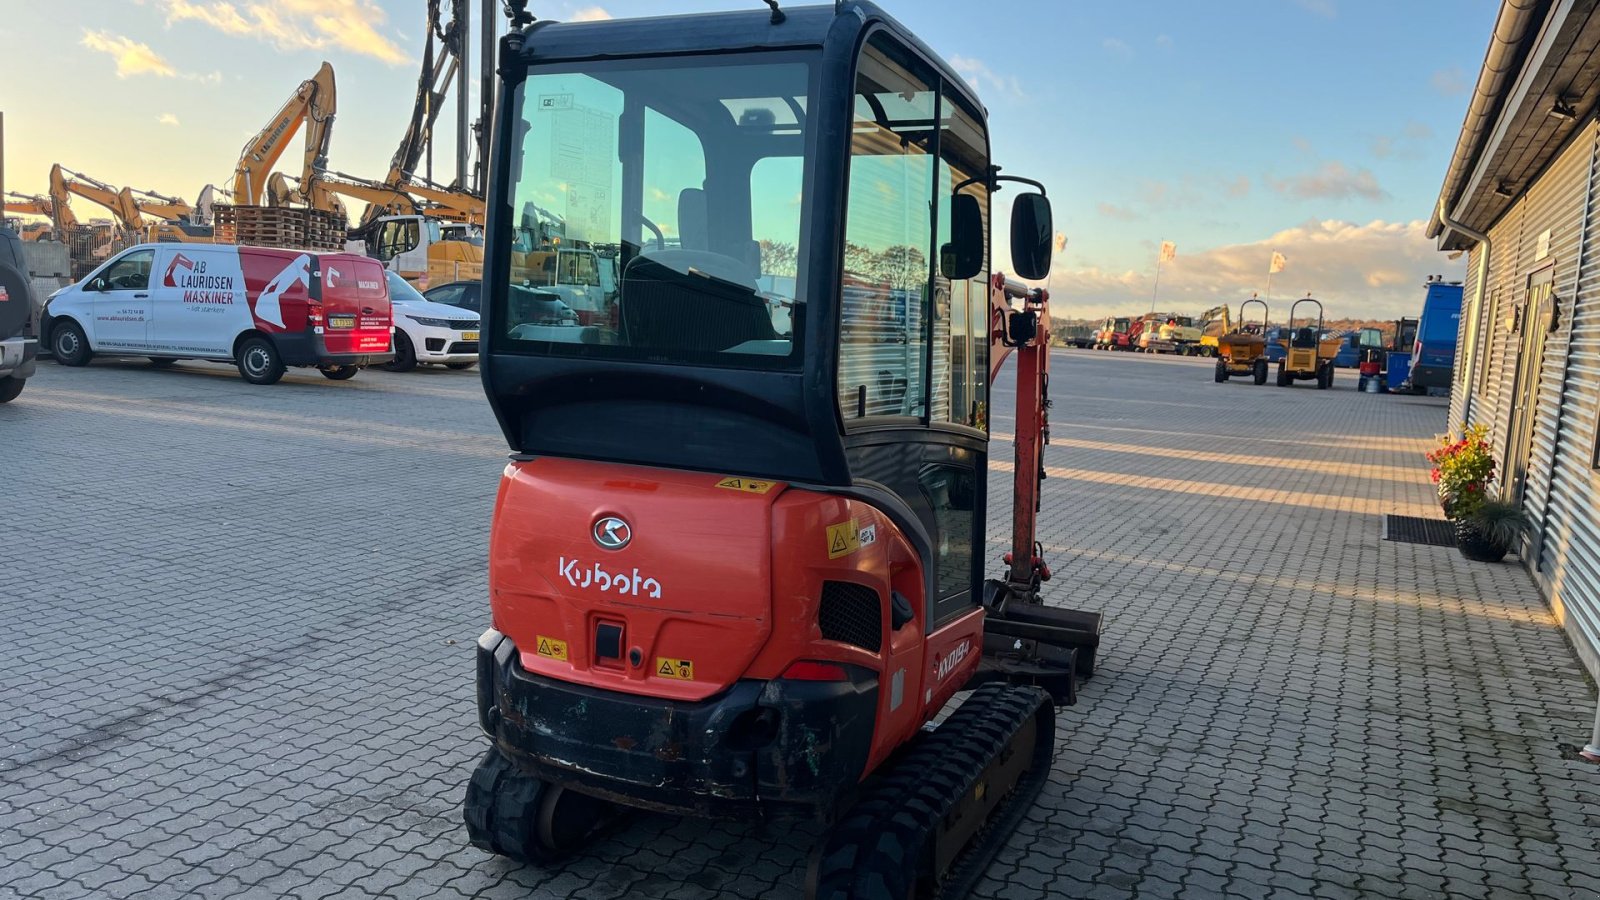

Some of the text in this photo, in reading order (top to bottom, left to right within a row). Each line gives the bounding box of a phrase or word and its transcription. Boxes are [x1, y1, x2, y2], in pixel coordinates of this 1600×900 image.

[193, 261, 206, 273] AB
[181, 275, 233, 290] LAURIDSEN
[183, 290, 233, 304] MASKINER
[559, 556, 661, 599] Kubota
